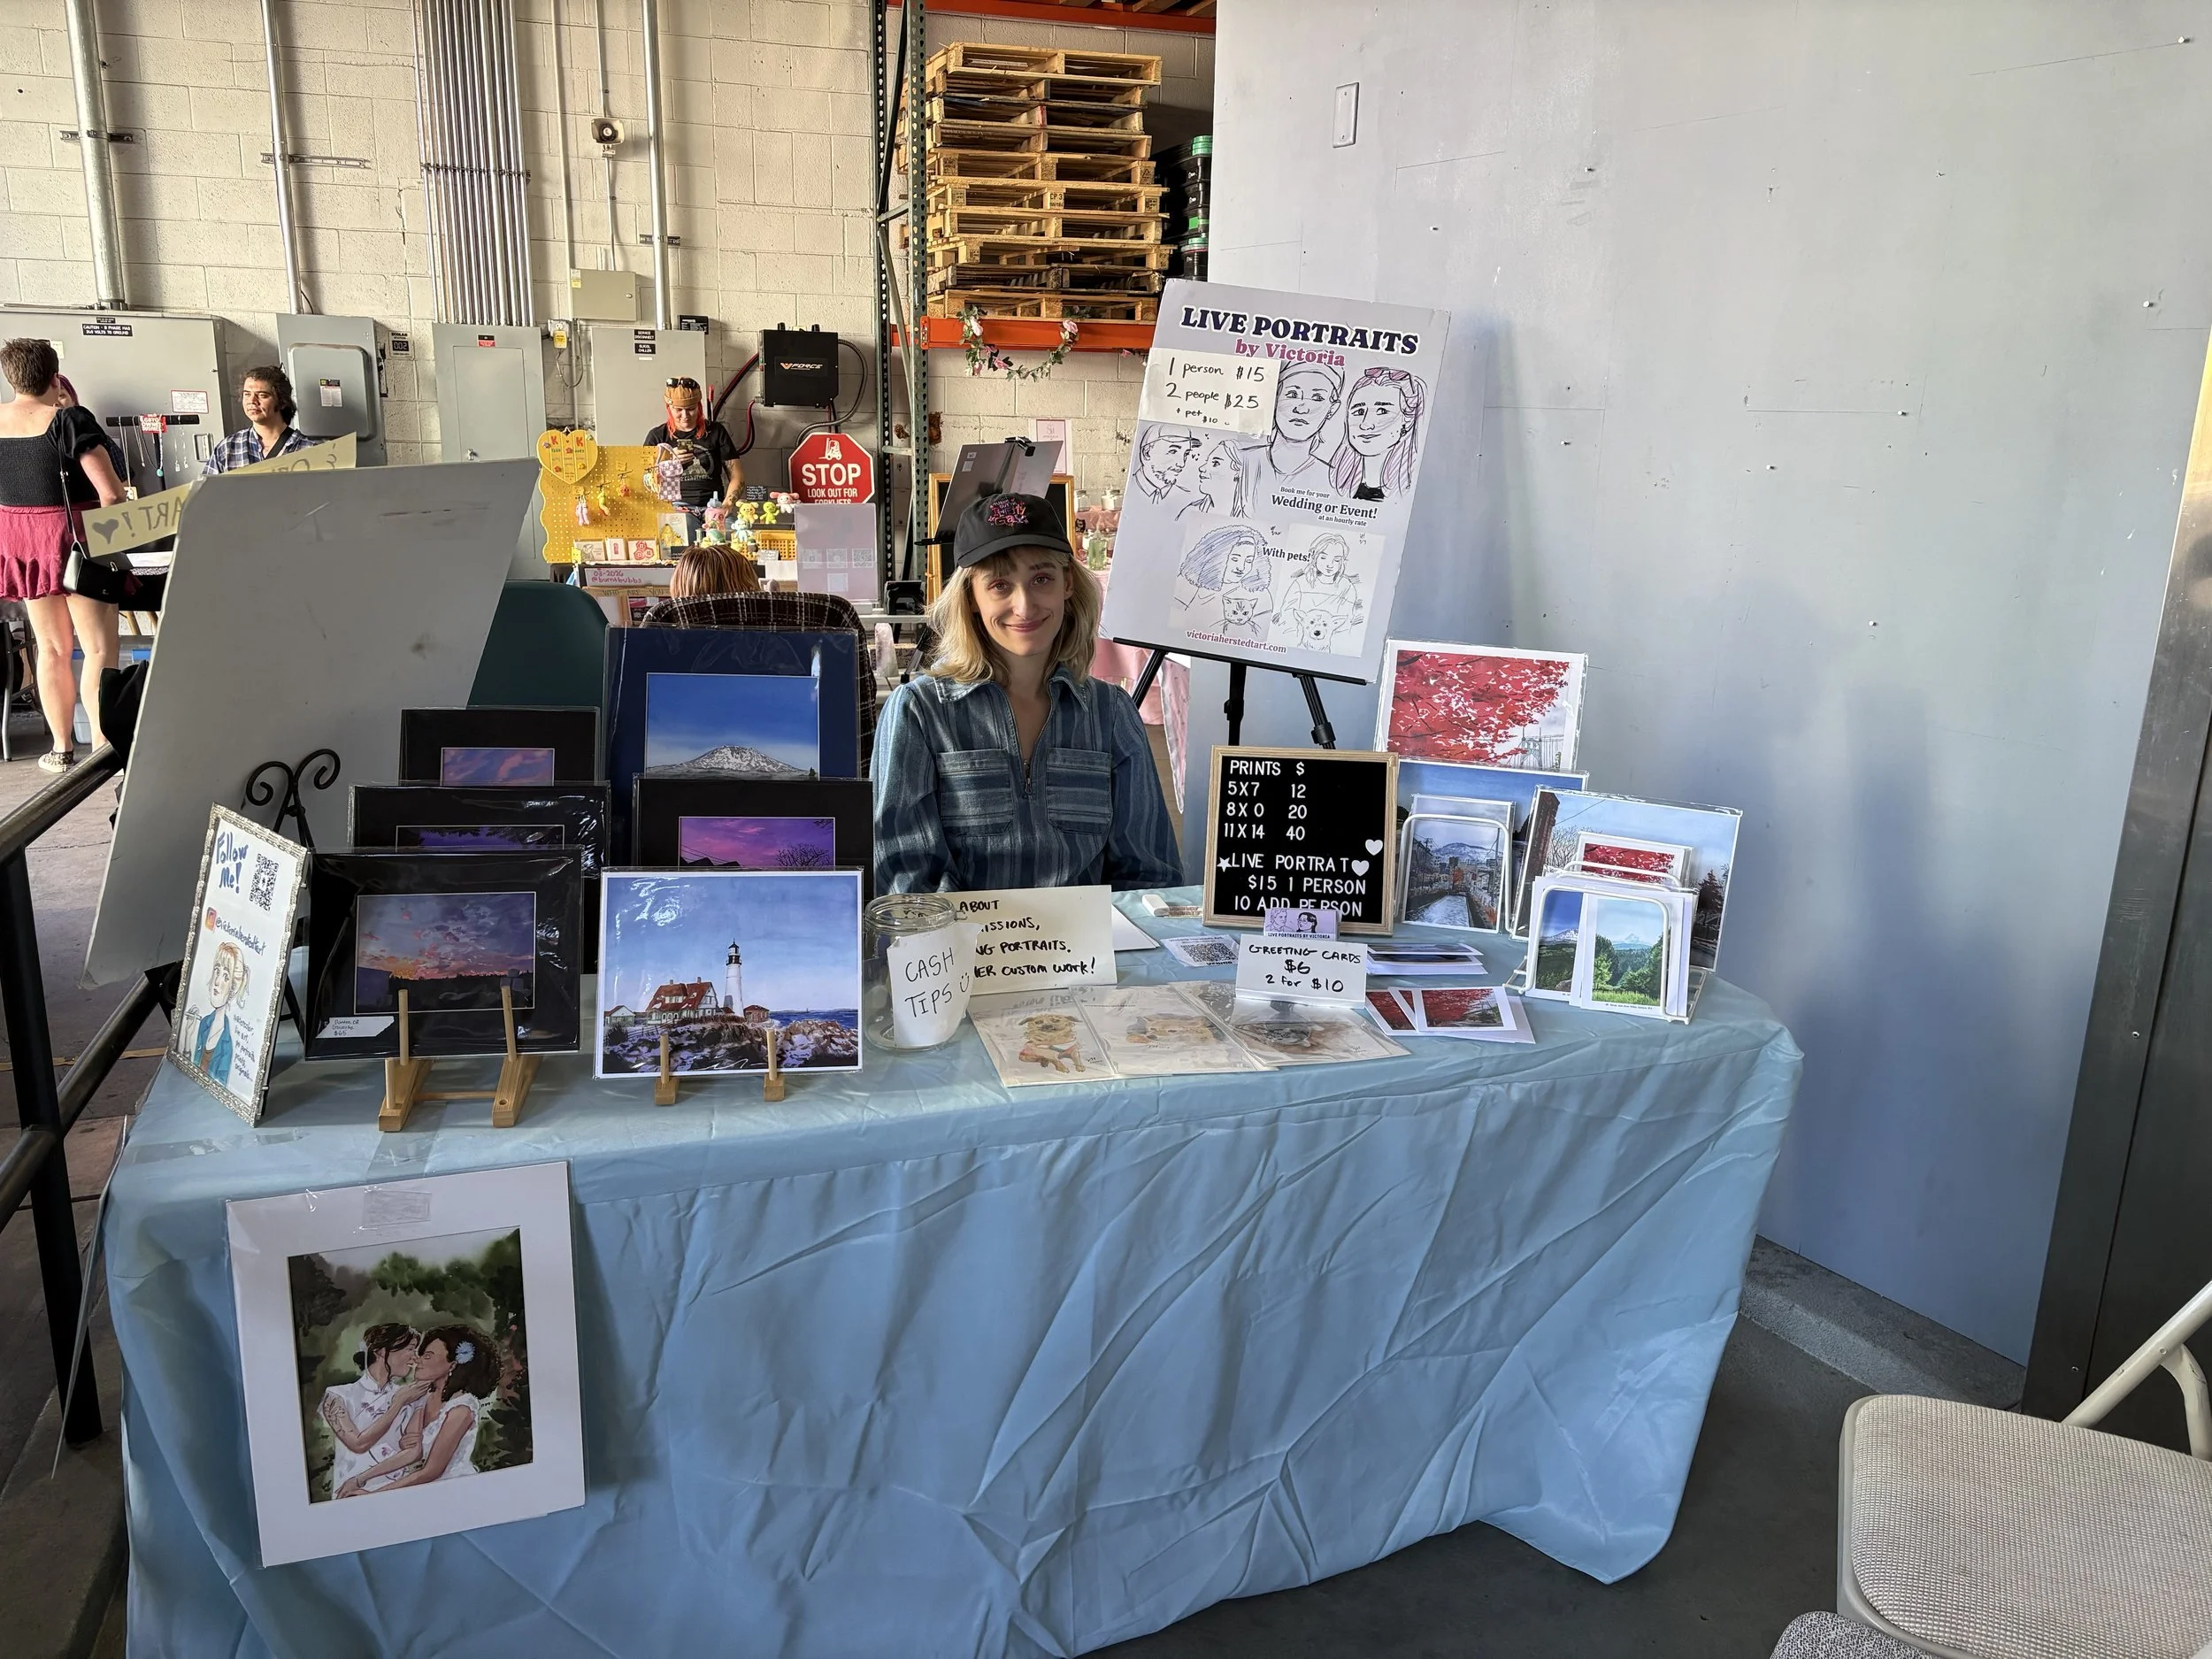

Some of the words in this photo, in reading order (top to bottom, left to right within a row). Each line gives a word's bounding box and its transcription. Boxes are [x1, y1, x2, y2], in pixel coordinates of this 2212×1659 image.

[1181, 307, 1248, 334] LIVE
[1252, 315, 1419, 355] PORTRAITS
[1234, 338, 1260, 358] by
[1263, 342, 1346, 366] Victoria
[1168, 357, 1176, 376] 1
[1182, 362, 1225, 379] person
[1235, 365, 1265, 382] $15
[1164, 381, 1182, 398] 2
[1185, 389, 1220, 402] people
[1224, 393, 1260, 410] $25
[801, 463, 862, 487] STOP
[807, 488, 827, 498] LOOK
[827, 488, 842, 497] OUT
[843, 488, 858, 498] FOR
[1271, 494, 1323, 514] Wedding
[1325, 504, 1339, 513] or
[1339, 503, 1379, 519] Event!
[1333, 516, 1355, 526] hourly
[1263, 546, 1286, 559] With
[1286, 549, 1312, 563] pets!
[1186, 629, 1287, 654] victoriaherstedtart.com
[1229, 759, 1282, 776] PRINTS
[1295, 761, 1305, 776] $
[1227, 780, 1260, 797] 5X7
[1290, 783, 1307, 799] 12
[1287, 804, 1308, 819] 20
[1286, 826, 1306, 841] 40
[215, 831, 250, 864] Follow
[1231, 852, 1264, 869] LIVE
[219, 861, 242, 894] Me!
[1248, 874, 1278, 891] $15
[1288, 876, 1294, 893] 1
[1302, 876, 1367, 895] PERSON
[959, 899, 1000, 913] ABOUT
[1234, 895, 1251, 911] 10
[1256, 895, 1291, 912] ADD
[980, 916, 1041, 933] ISSIONS,
[999, 940, 1071, 954] PORTRAITS.
[1248, 943, 1317, 957] GREETING
[1321, 949, 1362, 964] CARDS
[904, 947, 956, 983] CASH
[1283, 958, 1311, 975] $6
[1264, 973, 1276, 984] 2
[1310, 977, 1345, 993] $10
[903, 982, 953, 1018] TIPS
